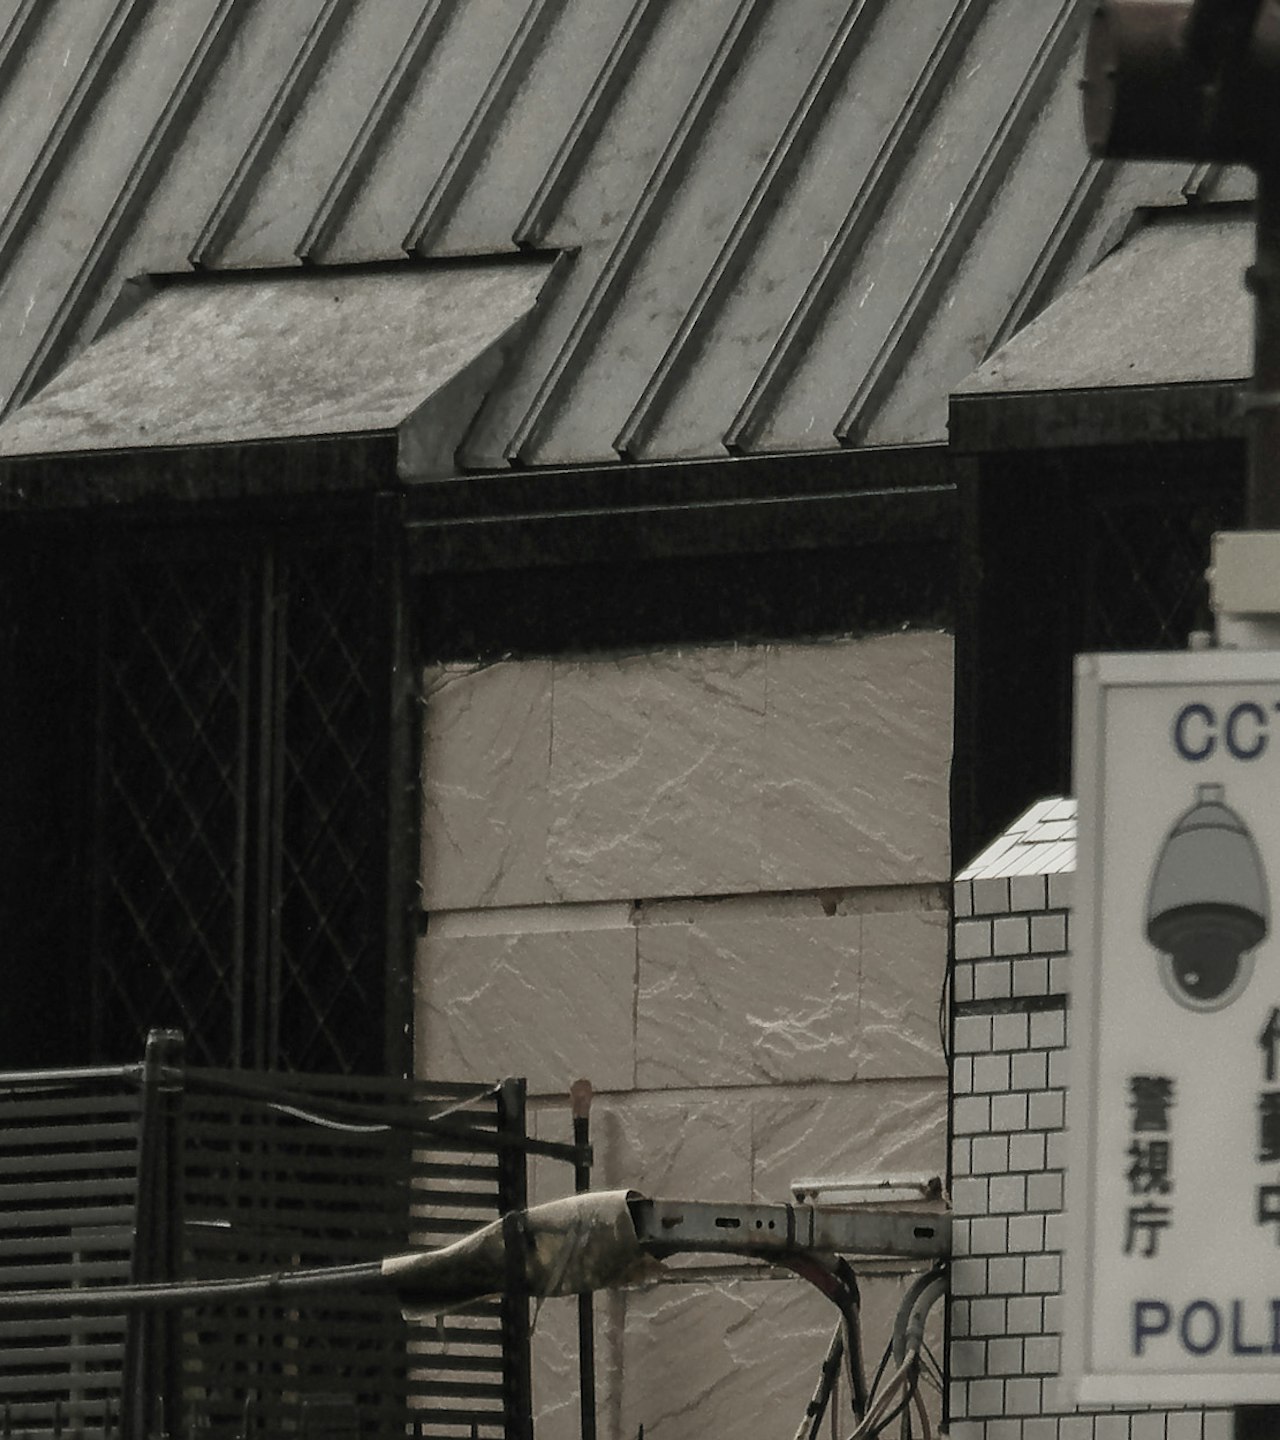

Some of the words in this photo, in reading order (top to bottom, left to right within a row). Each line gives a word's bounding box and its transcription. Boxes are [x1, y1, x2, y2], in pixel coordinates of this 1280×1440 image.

[1175, 702, 1280, 761] CC
[1124, 1076, 1174, 1258] 警視庁
